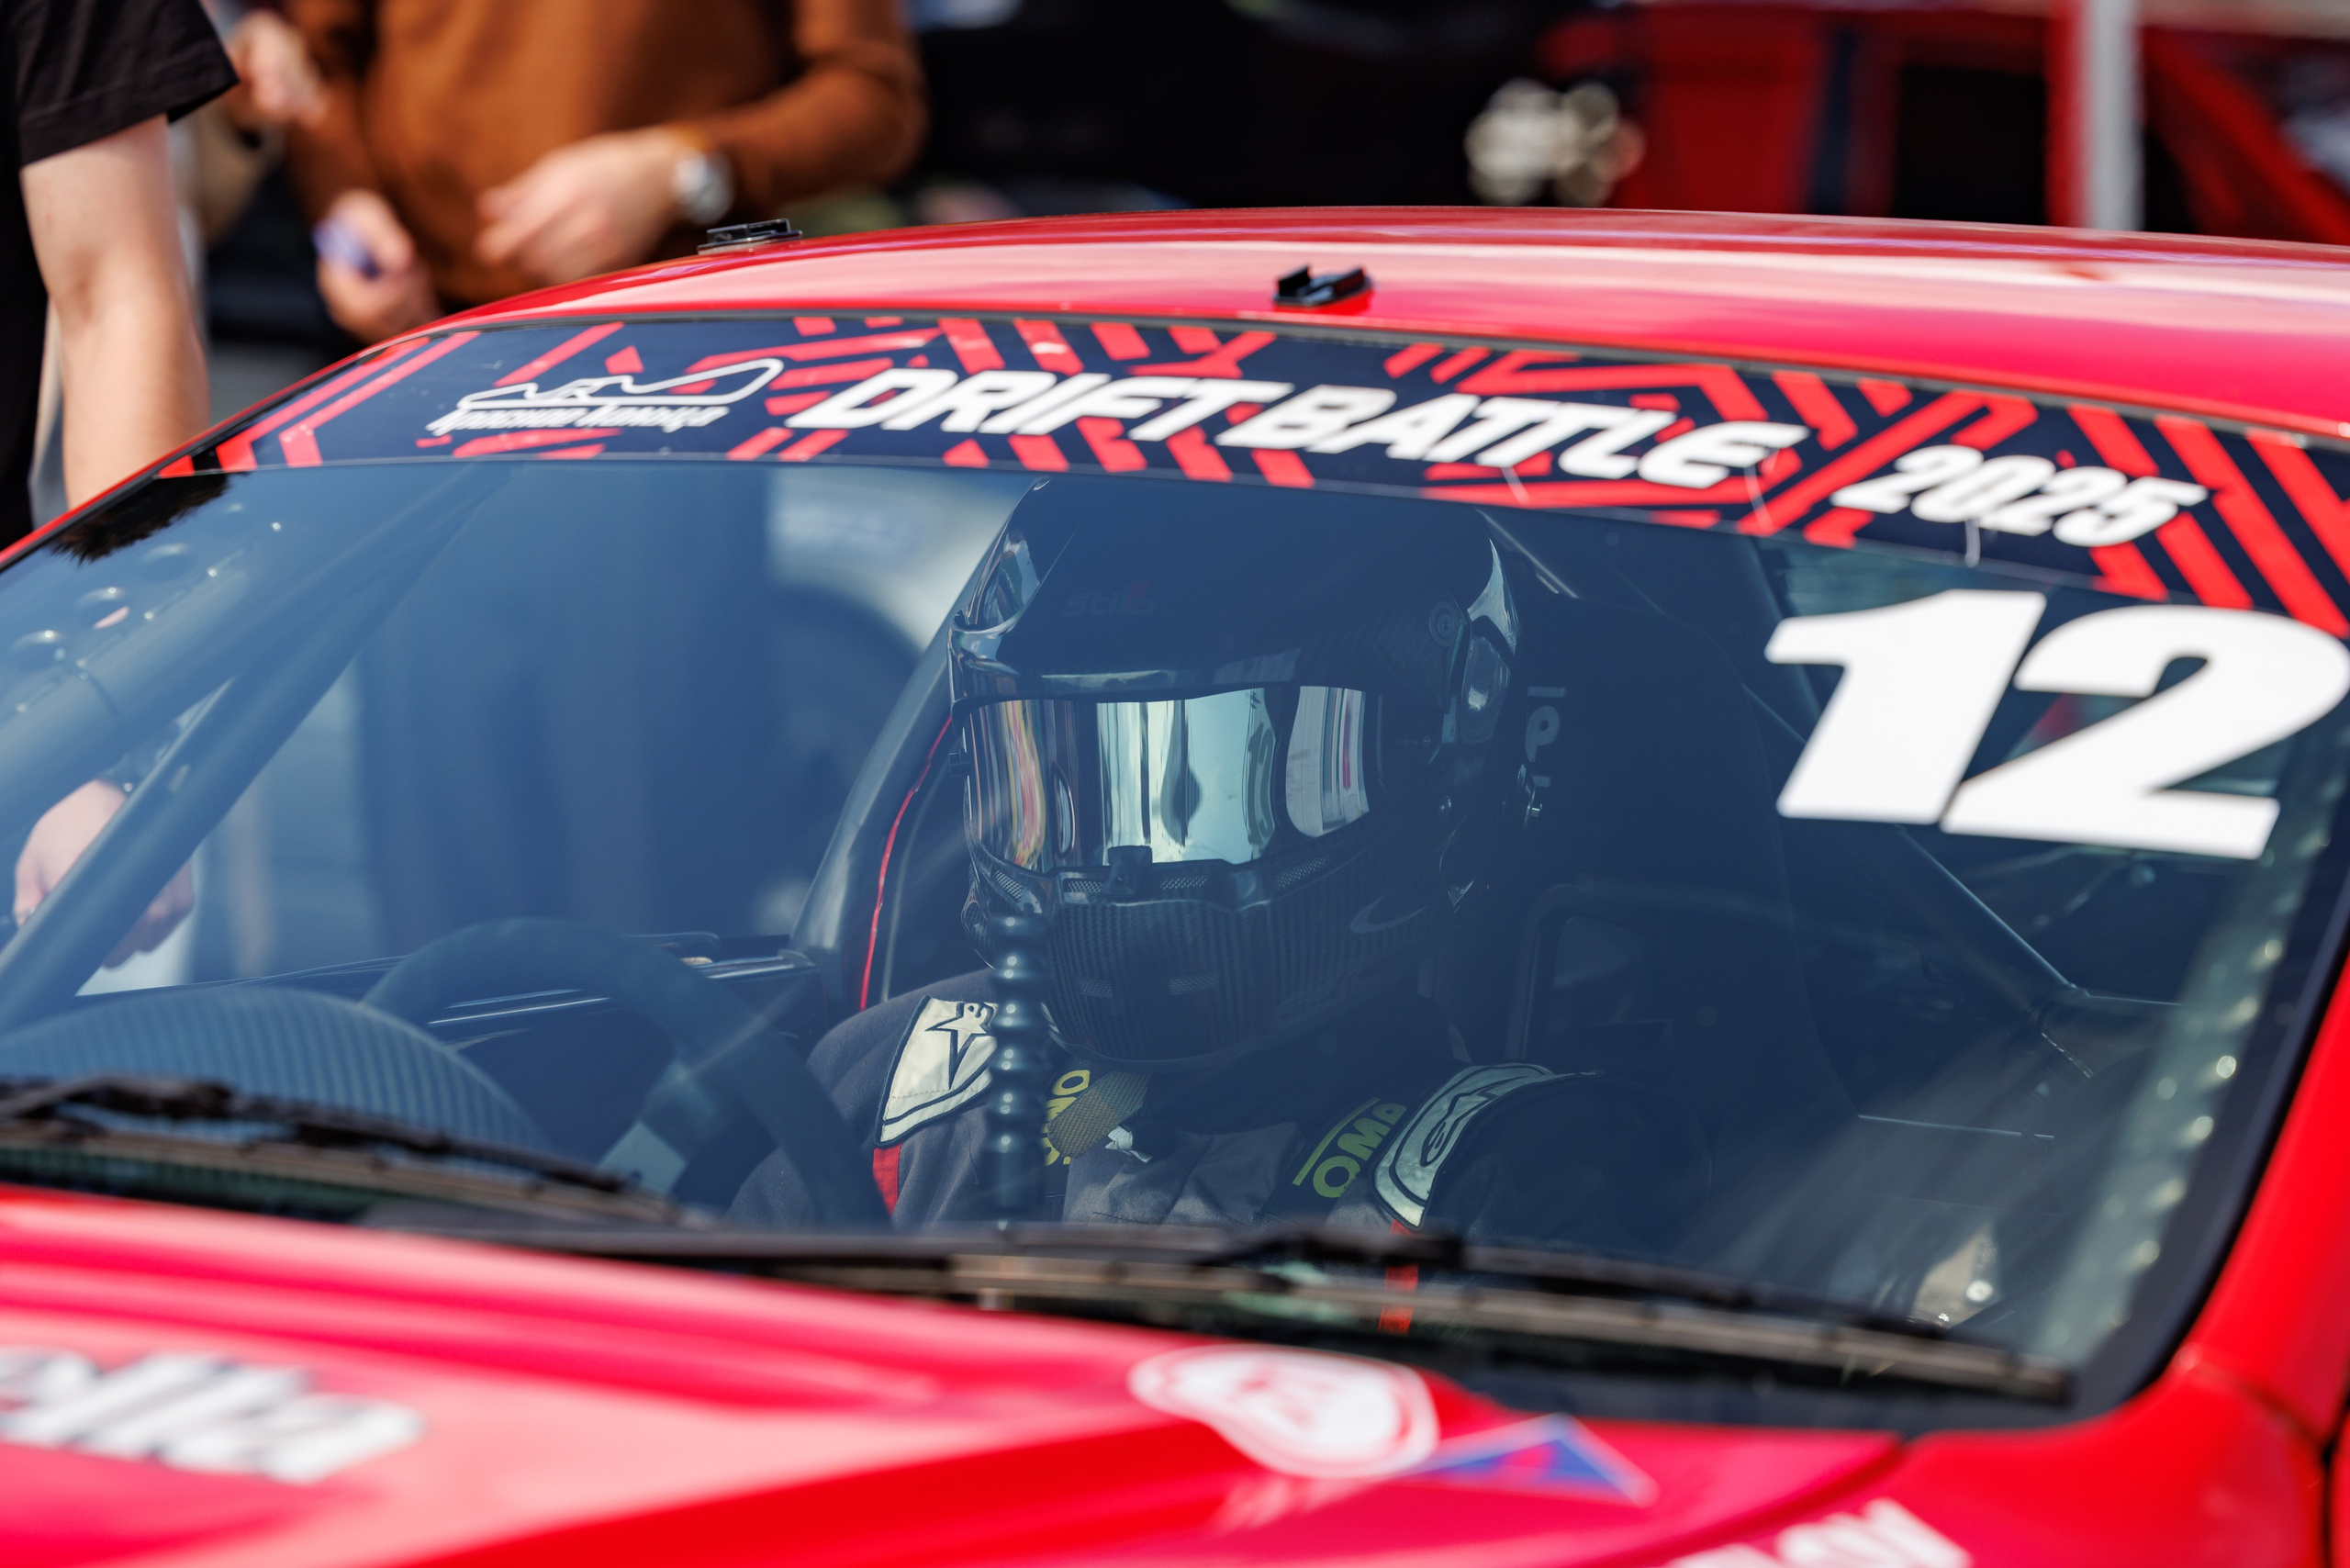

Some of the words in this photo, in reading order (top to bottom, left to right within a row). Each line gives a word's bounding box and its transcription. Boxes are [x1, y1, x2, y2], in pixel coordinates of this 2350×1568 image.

[785, 367, 1293, 442] DRIFT
[1214, 384, 1809, 488] BATTLE
[1830, 444, 2209, 547] 2025
[1763, 588, 2350, 861] 12
